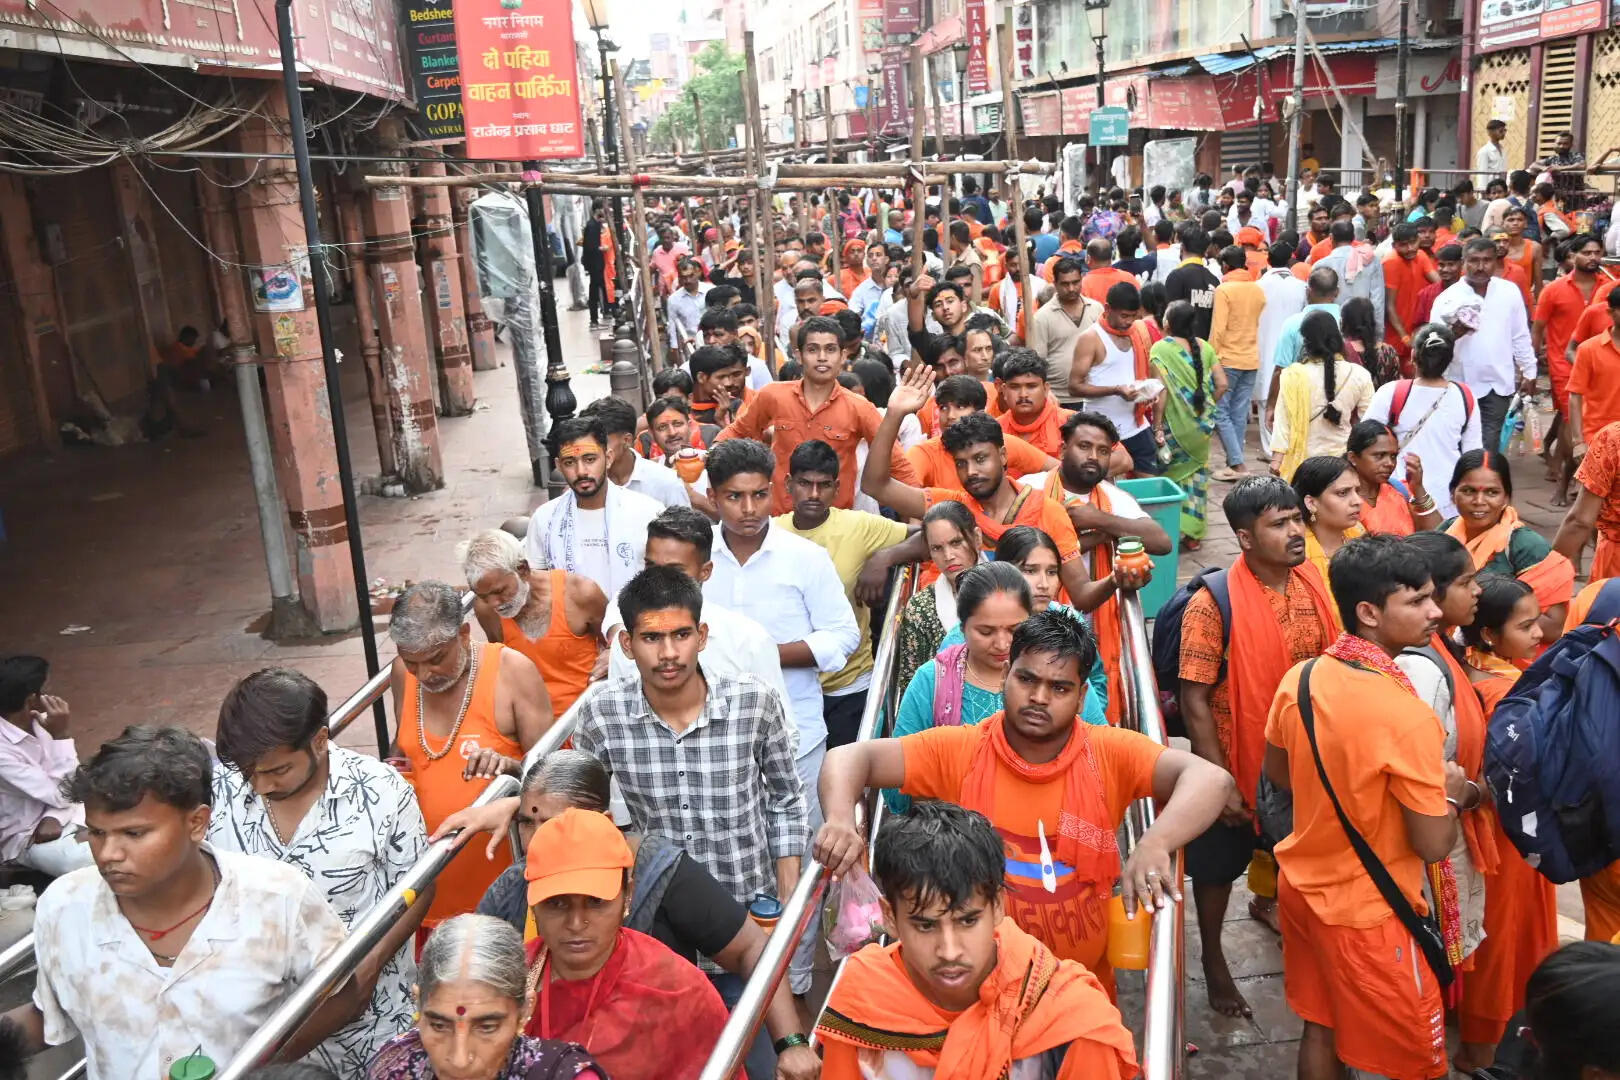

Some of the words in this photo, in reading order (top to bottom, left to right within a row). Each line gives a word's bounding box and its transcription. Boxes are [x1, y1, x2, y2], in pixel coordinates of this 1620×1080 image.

[410, 8, 453, 22] Bedshee
[482, 16, 508, 29] नगर
[510, 12, 544, 28] निगम
[971, 9, 982, 59] LARA
[481, 47, 500, 69] दो
[503, 45, 550, 70] पहिया
[466, 82, 512, 102] वाहन
[549, 122, 575, 134] घाट
